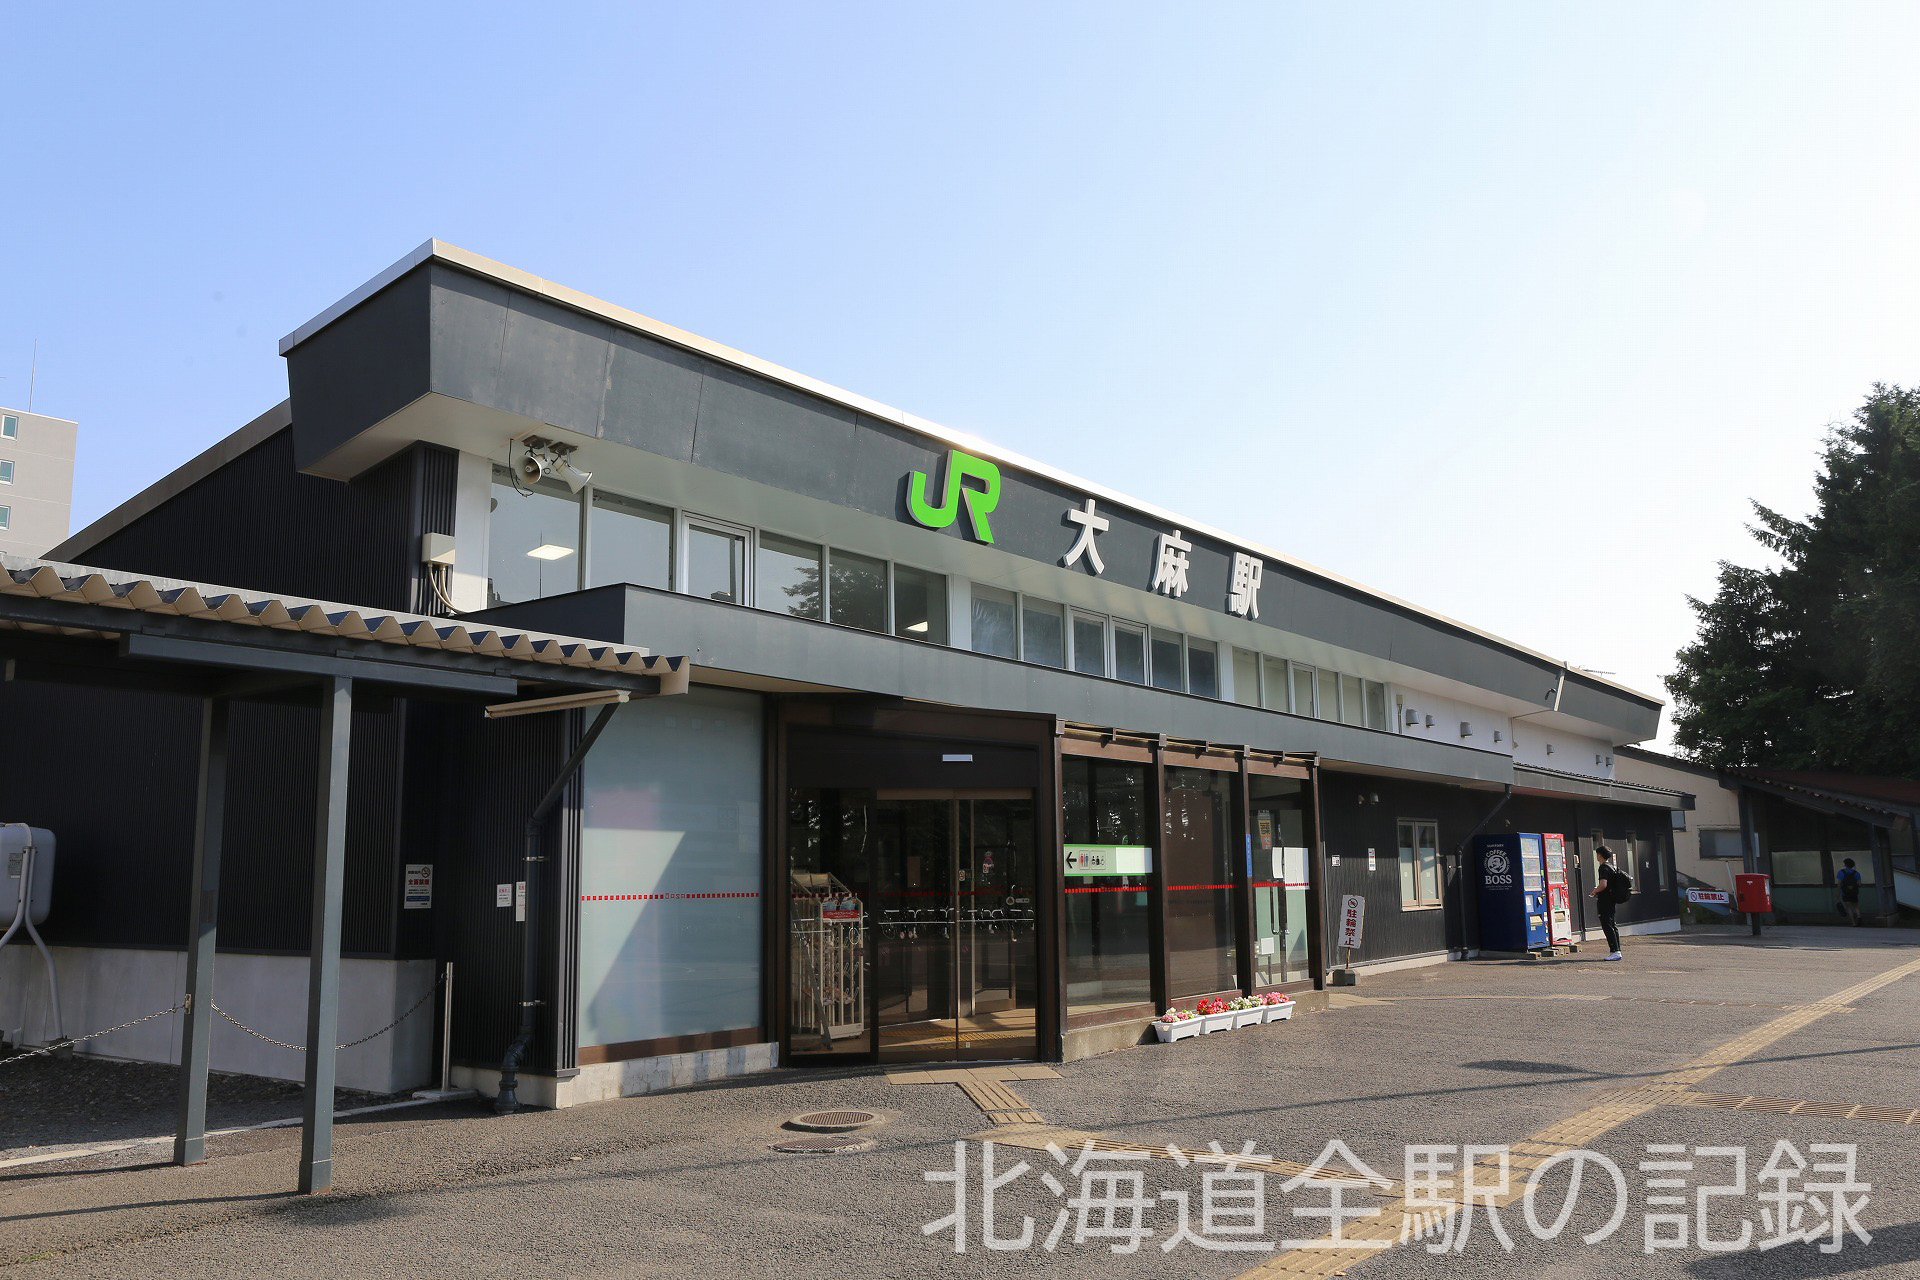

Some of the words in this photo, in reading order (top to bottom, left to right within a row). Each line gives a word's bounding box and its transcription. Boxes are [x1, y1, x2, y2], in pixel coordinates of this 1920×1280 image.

[906, 449, 1001, 544] JR
[1061, 498, 1264, 620] 大麻駅
[1485, 849, 1507, 858] COFFEE
[1484, 874, 1513, 885] BOSS
[1344, 908, 1358, 947] 駐輪禁止
